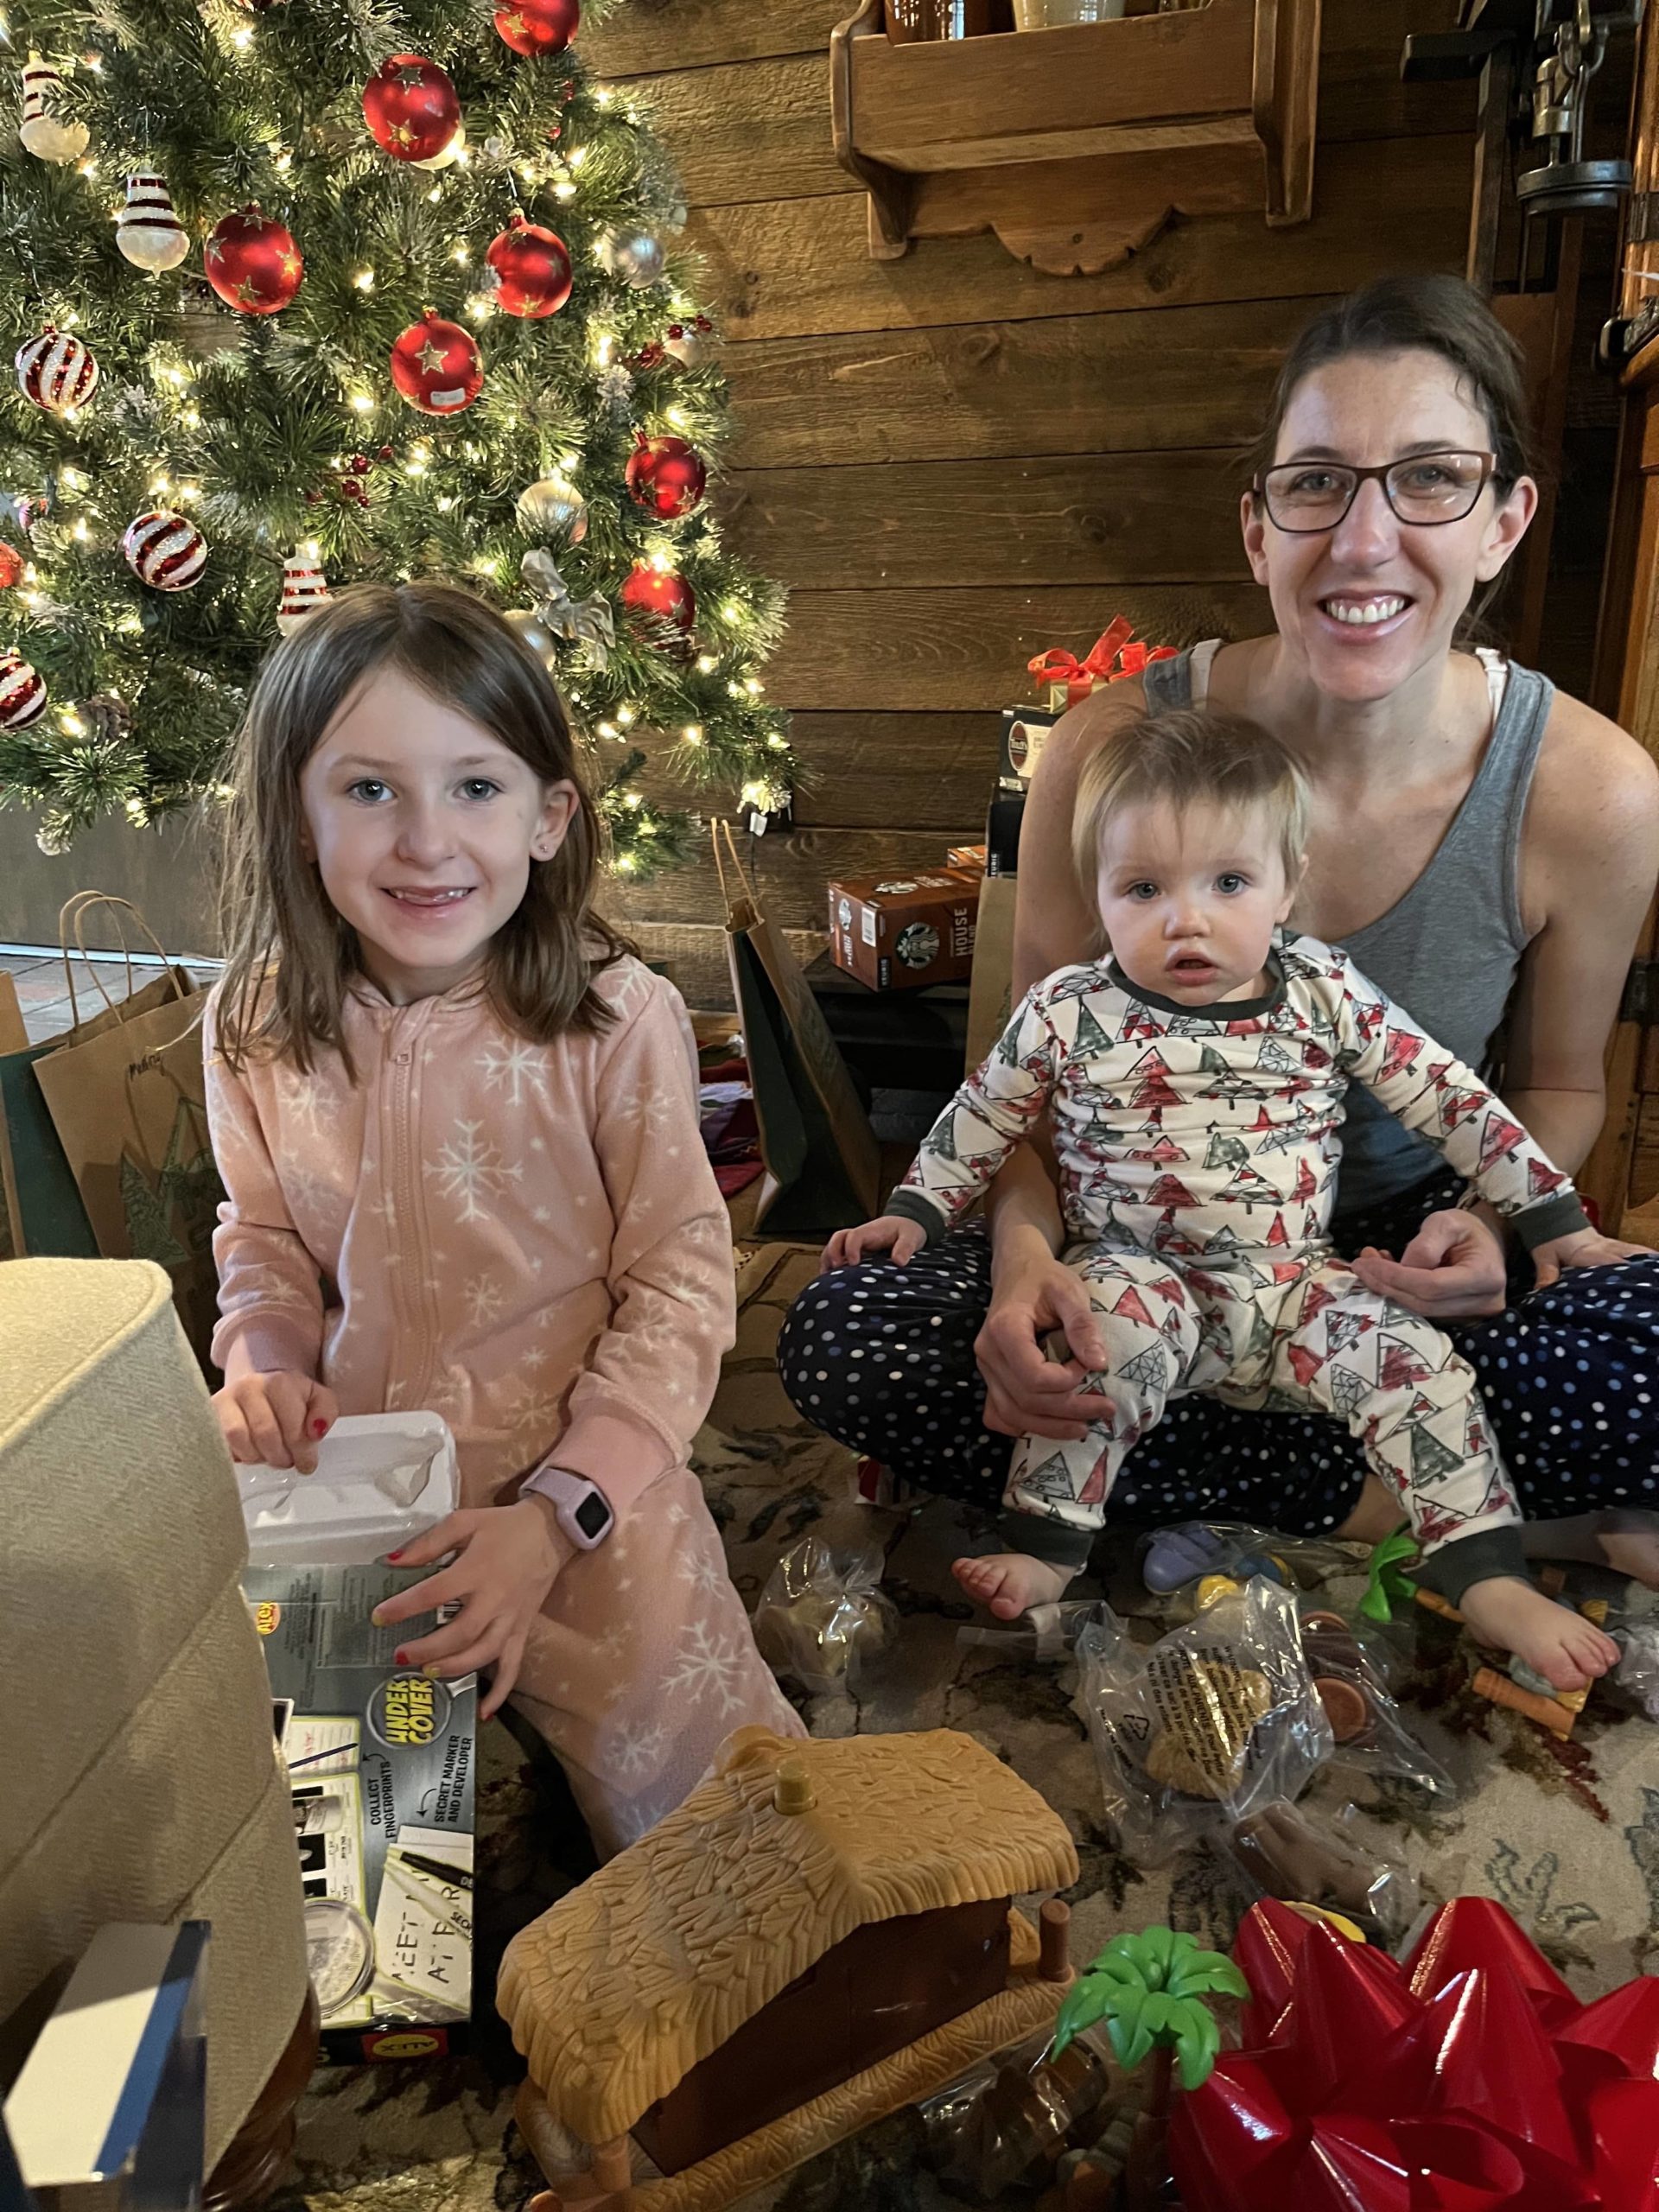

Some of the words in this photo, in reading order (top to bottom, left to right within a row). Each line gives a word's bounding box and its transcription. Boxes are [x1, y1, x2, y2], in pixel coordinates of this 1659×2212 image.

[953, 907, 968, 956] HOUSE
[386, 1680, 410, 1743] UNDER
[408, 1679, 435, 1744] COVER
[1236, 1712, 1247, 1728] this
[442, 1735, 461, 1779] MARKER
[452, 1738, 472, 1796] DEVELOPER
[367, 1778, 381, 1825] COLLECT
[381, 1761, 396, 1839] FINGERPRINTS
[435, 1782, 450, 1822] SECRET
[448, 1800, 461, 1822] AND
[379, 2041, 435, 2052] ALEX
